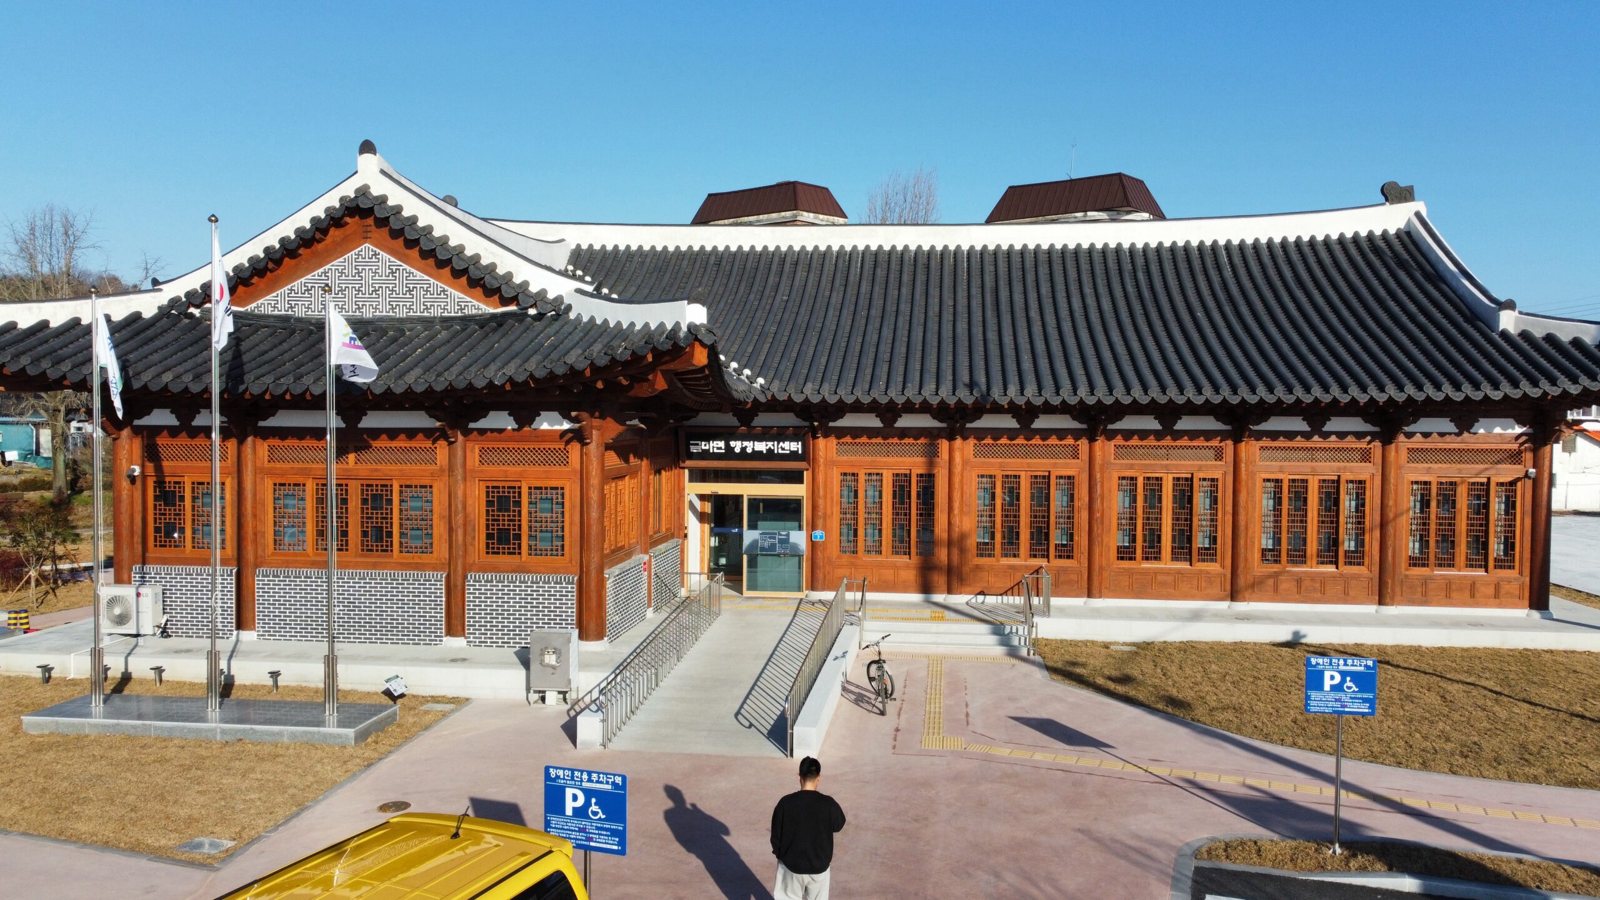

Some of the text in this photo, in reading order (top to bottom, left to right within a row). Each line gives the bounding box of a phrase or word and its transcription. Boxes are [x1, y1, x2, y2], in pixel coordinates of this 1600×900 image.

[690, 440, 802, 454] 금마면 행정복지센터
[1310, 657, 1373, 667] 장애인 전용 주차구역
[1324, 670, 1341, 691] P
[549, 768, 571, 779] 장애인
[574, 771, 588, 781] 전용
[591, 773, 622, 786] 주차구역
[565, 787, 585, 816] P
